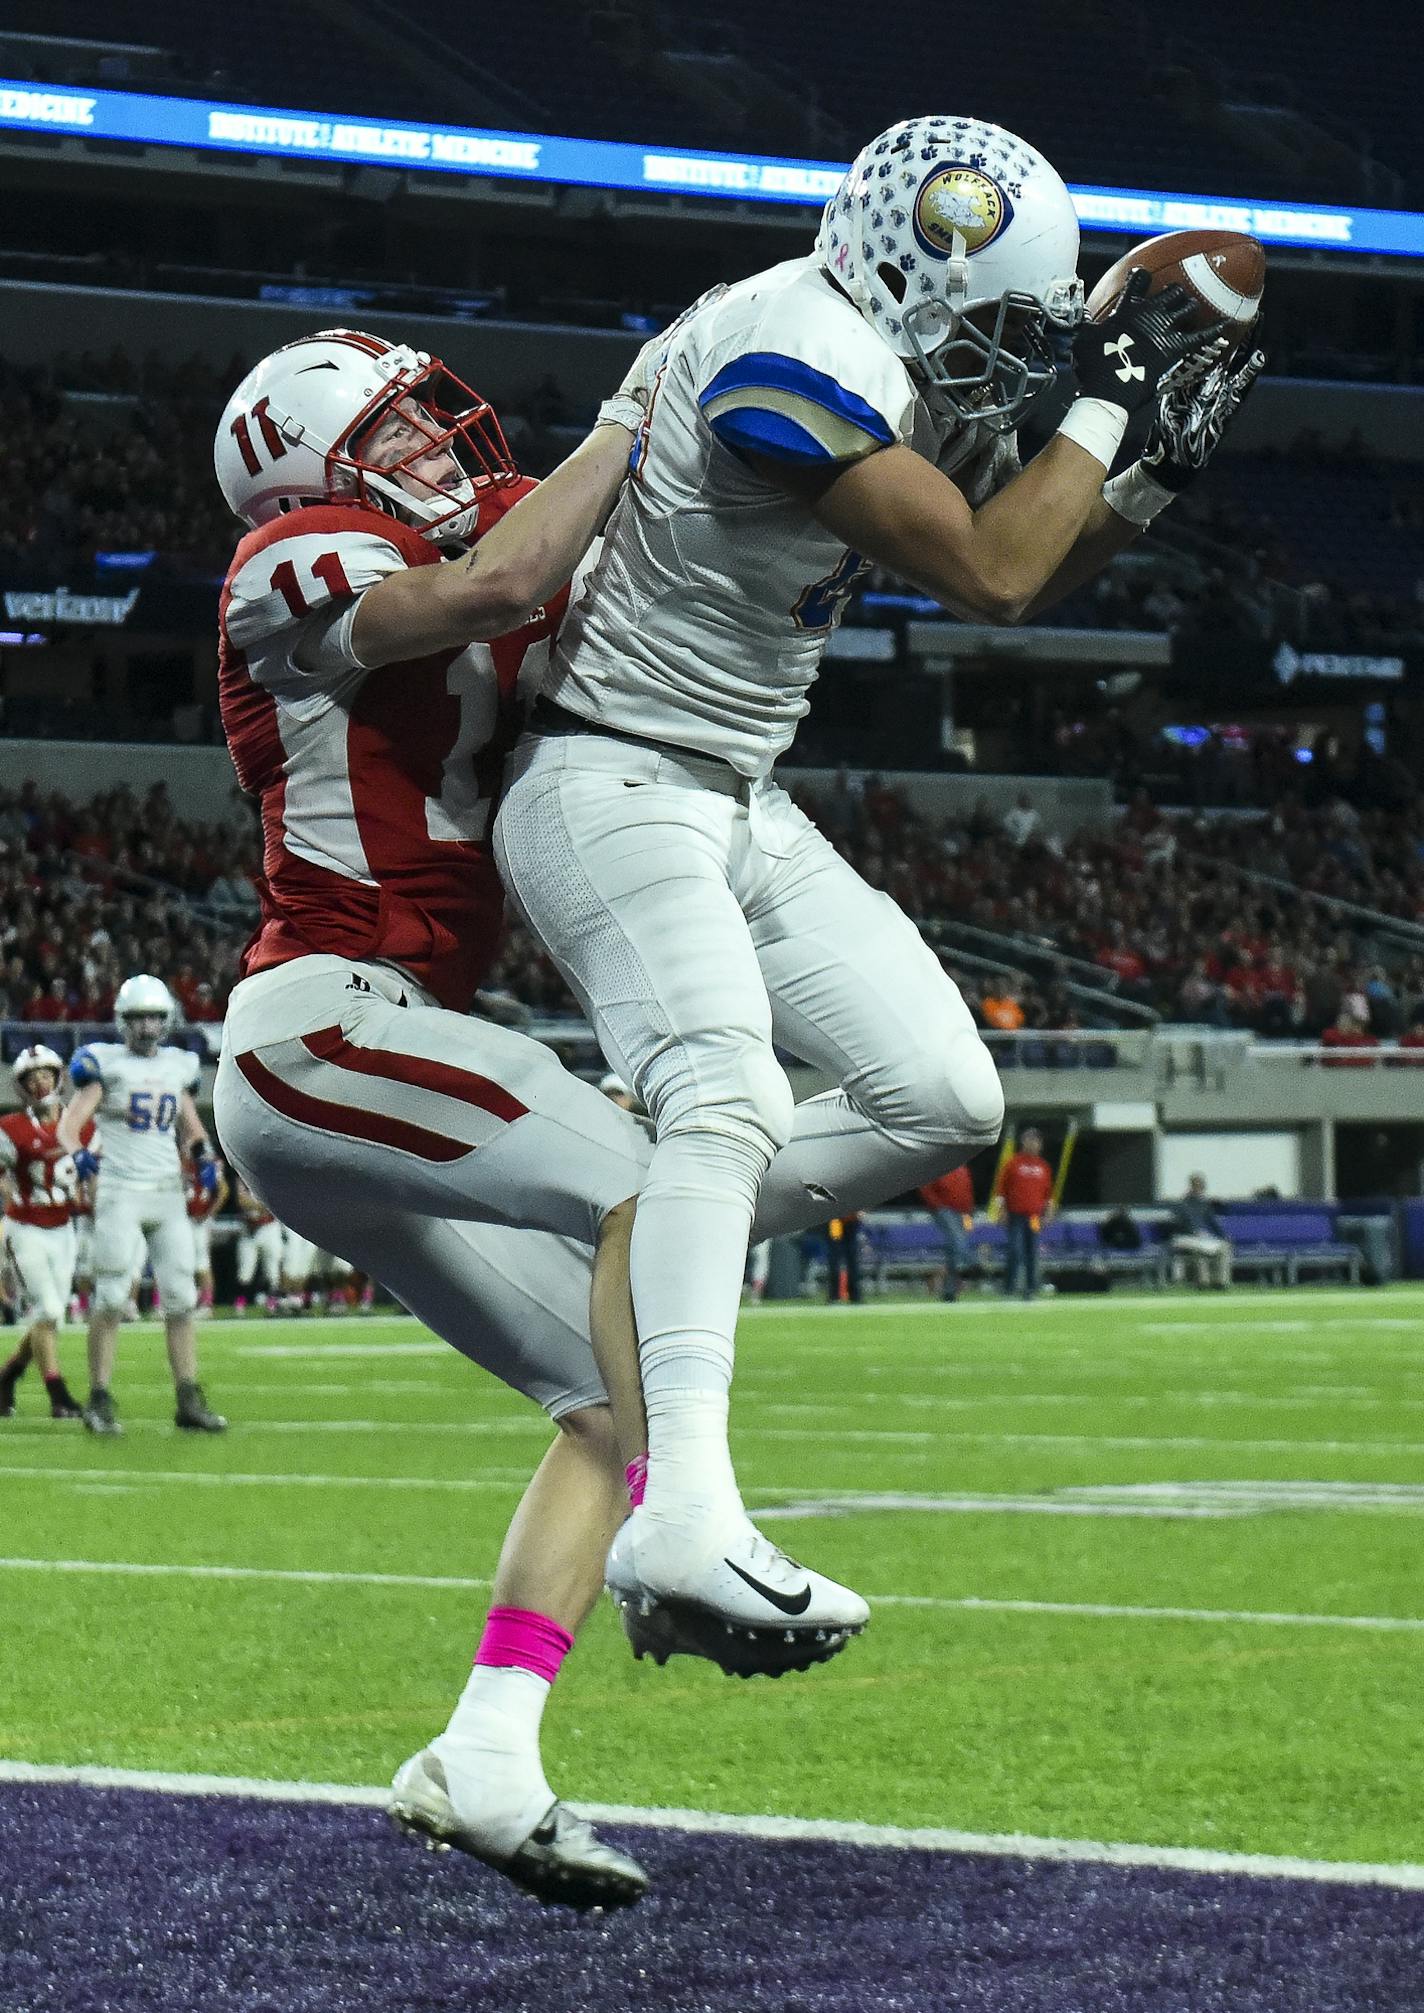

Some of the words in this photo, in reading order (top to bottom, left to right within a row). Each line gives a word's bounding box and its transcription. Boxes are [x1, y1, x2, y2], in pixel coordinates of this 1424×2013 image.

[432, 134, 541, 169] MEDICINE
[230, 396, 287, 478] 11
[269, 551, 353, 619] 11
[128, 1092, 177, 1132] 50
